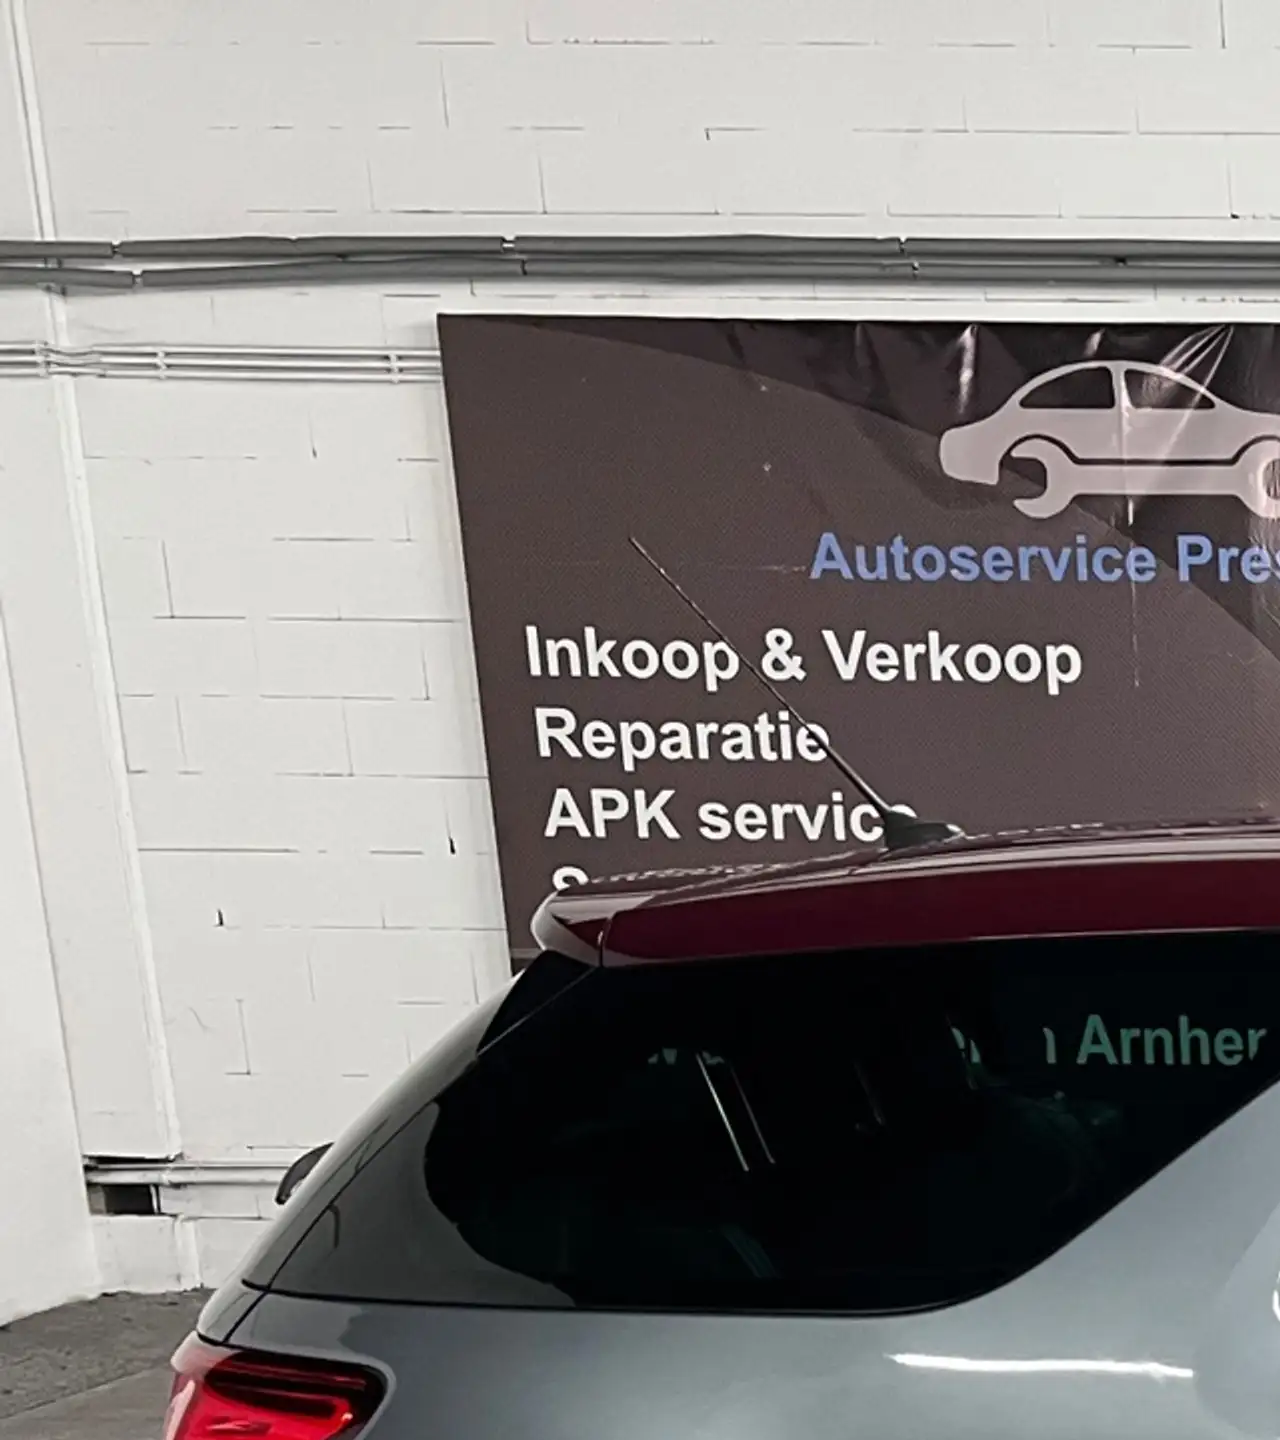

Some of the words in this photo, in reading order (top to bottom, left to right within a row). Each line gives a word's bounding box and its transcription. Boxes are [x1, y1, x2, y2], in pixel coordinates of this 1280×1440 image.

[810, 532, 1156, 582] Autoservice
[525, 625, 740, 692] Inkoop
[761, 626, 807, 682] &
[822, 628, 1083, 696] Verkoop
[533, 706, 830, 772] Reparatie
[543, 787, 681, 840] APK
[698, 791, 917, 842] servic
